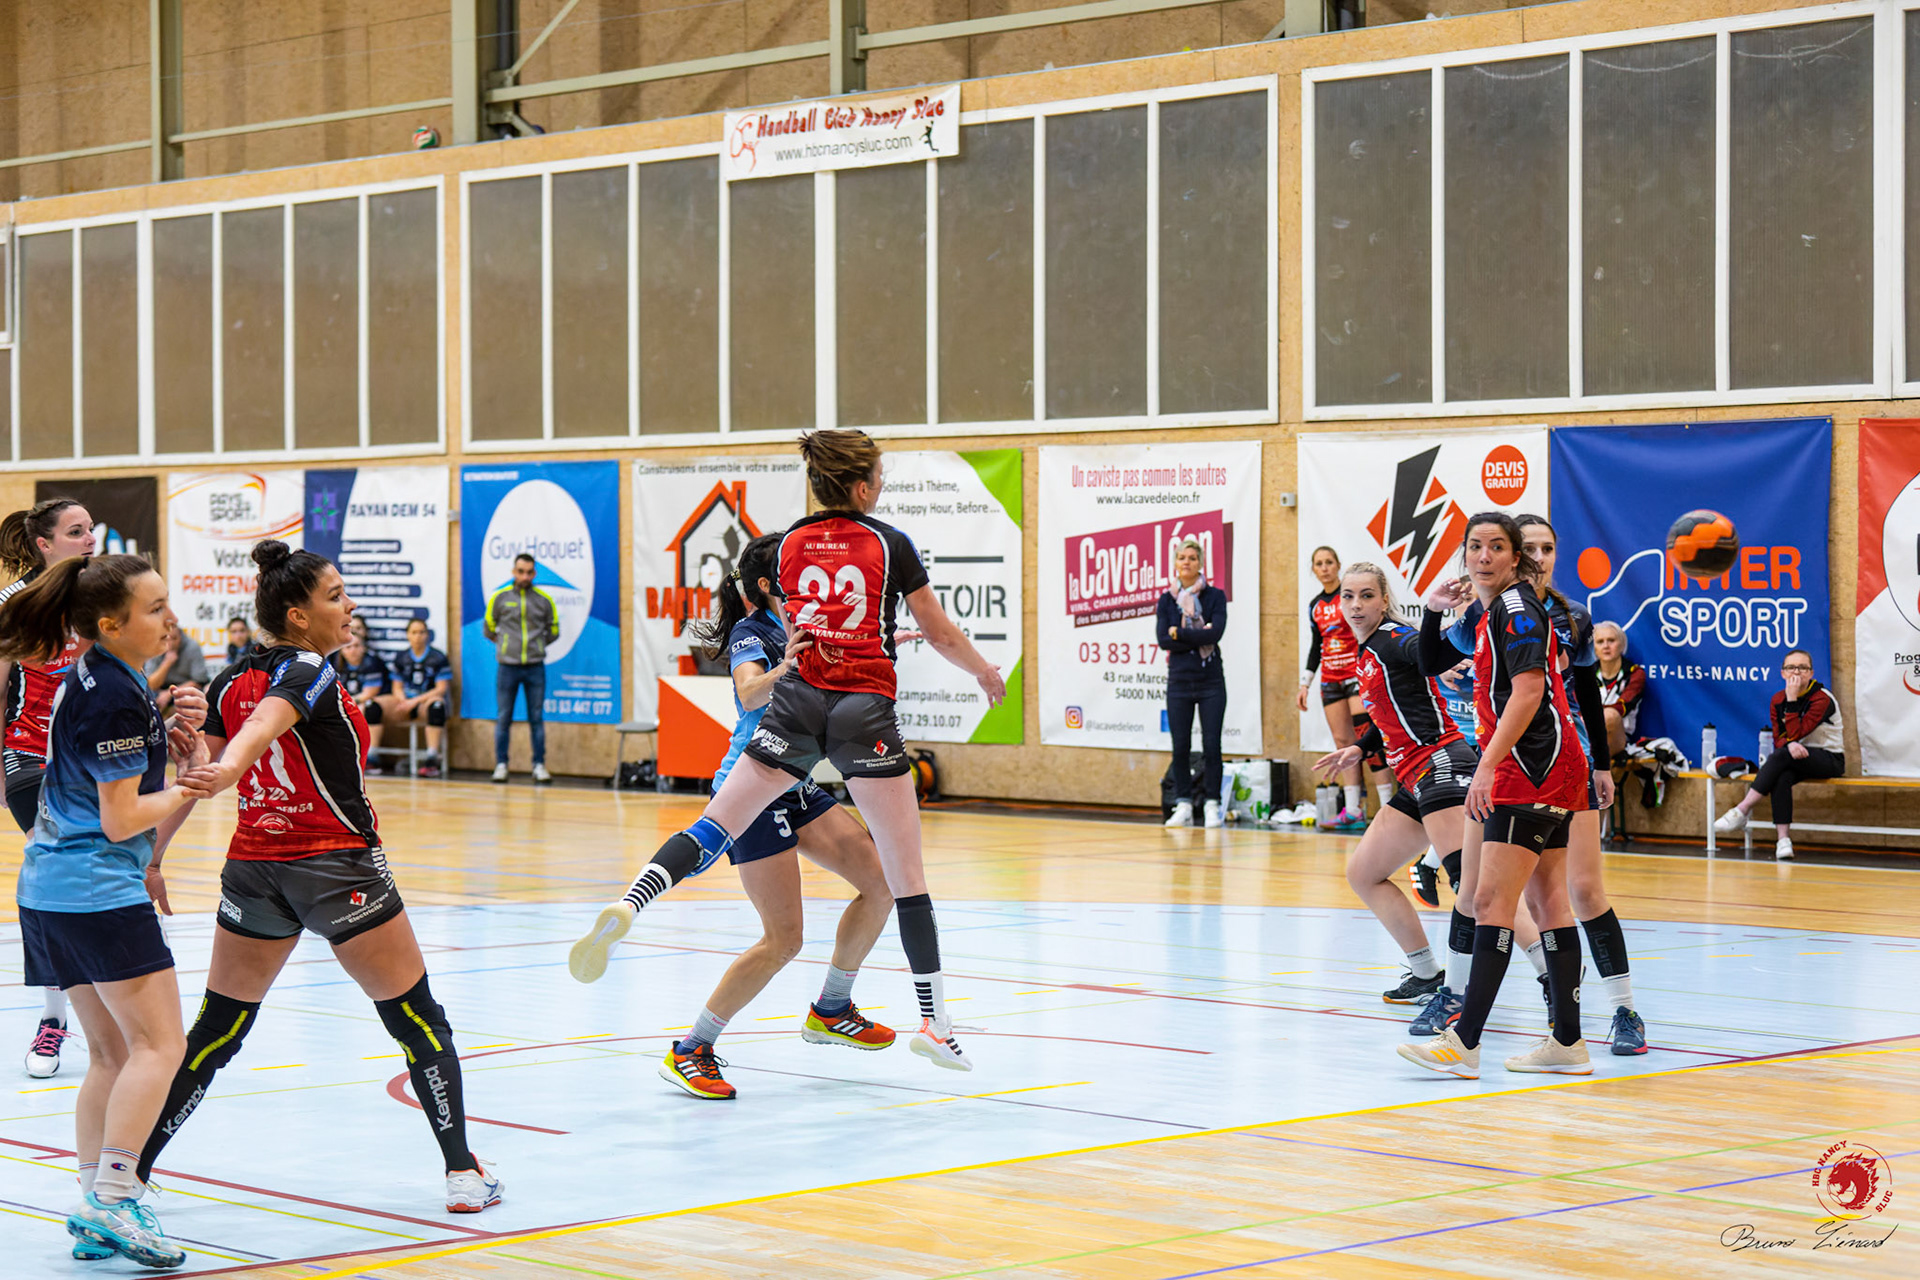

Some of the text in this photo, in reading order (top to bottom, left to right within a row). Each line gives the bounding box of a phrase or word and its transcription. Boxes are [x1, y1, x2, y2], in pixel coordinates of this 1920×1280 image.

[757, 96, 944, 138] Handball Club Nancy Sluc
[775, 134, 913, 162] www.hbcnancysluc.com
[639, 462, 800, 475] Construisons ensemble votre avenir
[1072, 463, 1226, 490] Un caviste pas comme les autres
[1485, 461, 1525, 478] DEVIS
[1485, 477, 1525, 489] GRATUIT
[1096, 491, 1200, 505] www.lacavedeleon.fr
[391, 503, 419, 517] DEM
[422, 503, 437, 517] 54
[897, 503, 927, 516] Happy
[930, 503, 954, 515] Hour,
[525, 535, 584, 564] Hoquet
[1069, 521, 1214, 601] la Cave de Lén
[1665, 546, 1802, 590] IER
[182, 574, 258, 594] PARTENA
[219, 602, 257, 620] l'eff
[1658, 596, 1808, 648] SPORT
[806, 628, 835, 639] AYAN
[1079, 642, 1159, 665] 03 83 17
[1894, 653, 1920, 664] Prog
[1103, 671, 1168, 685] 43 rue Marce
[1115, 688, 1168, 701] 54000 NAN
[772, 808, 793, 838] 5
[423, 1064, 454, 1131] Kempa
